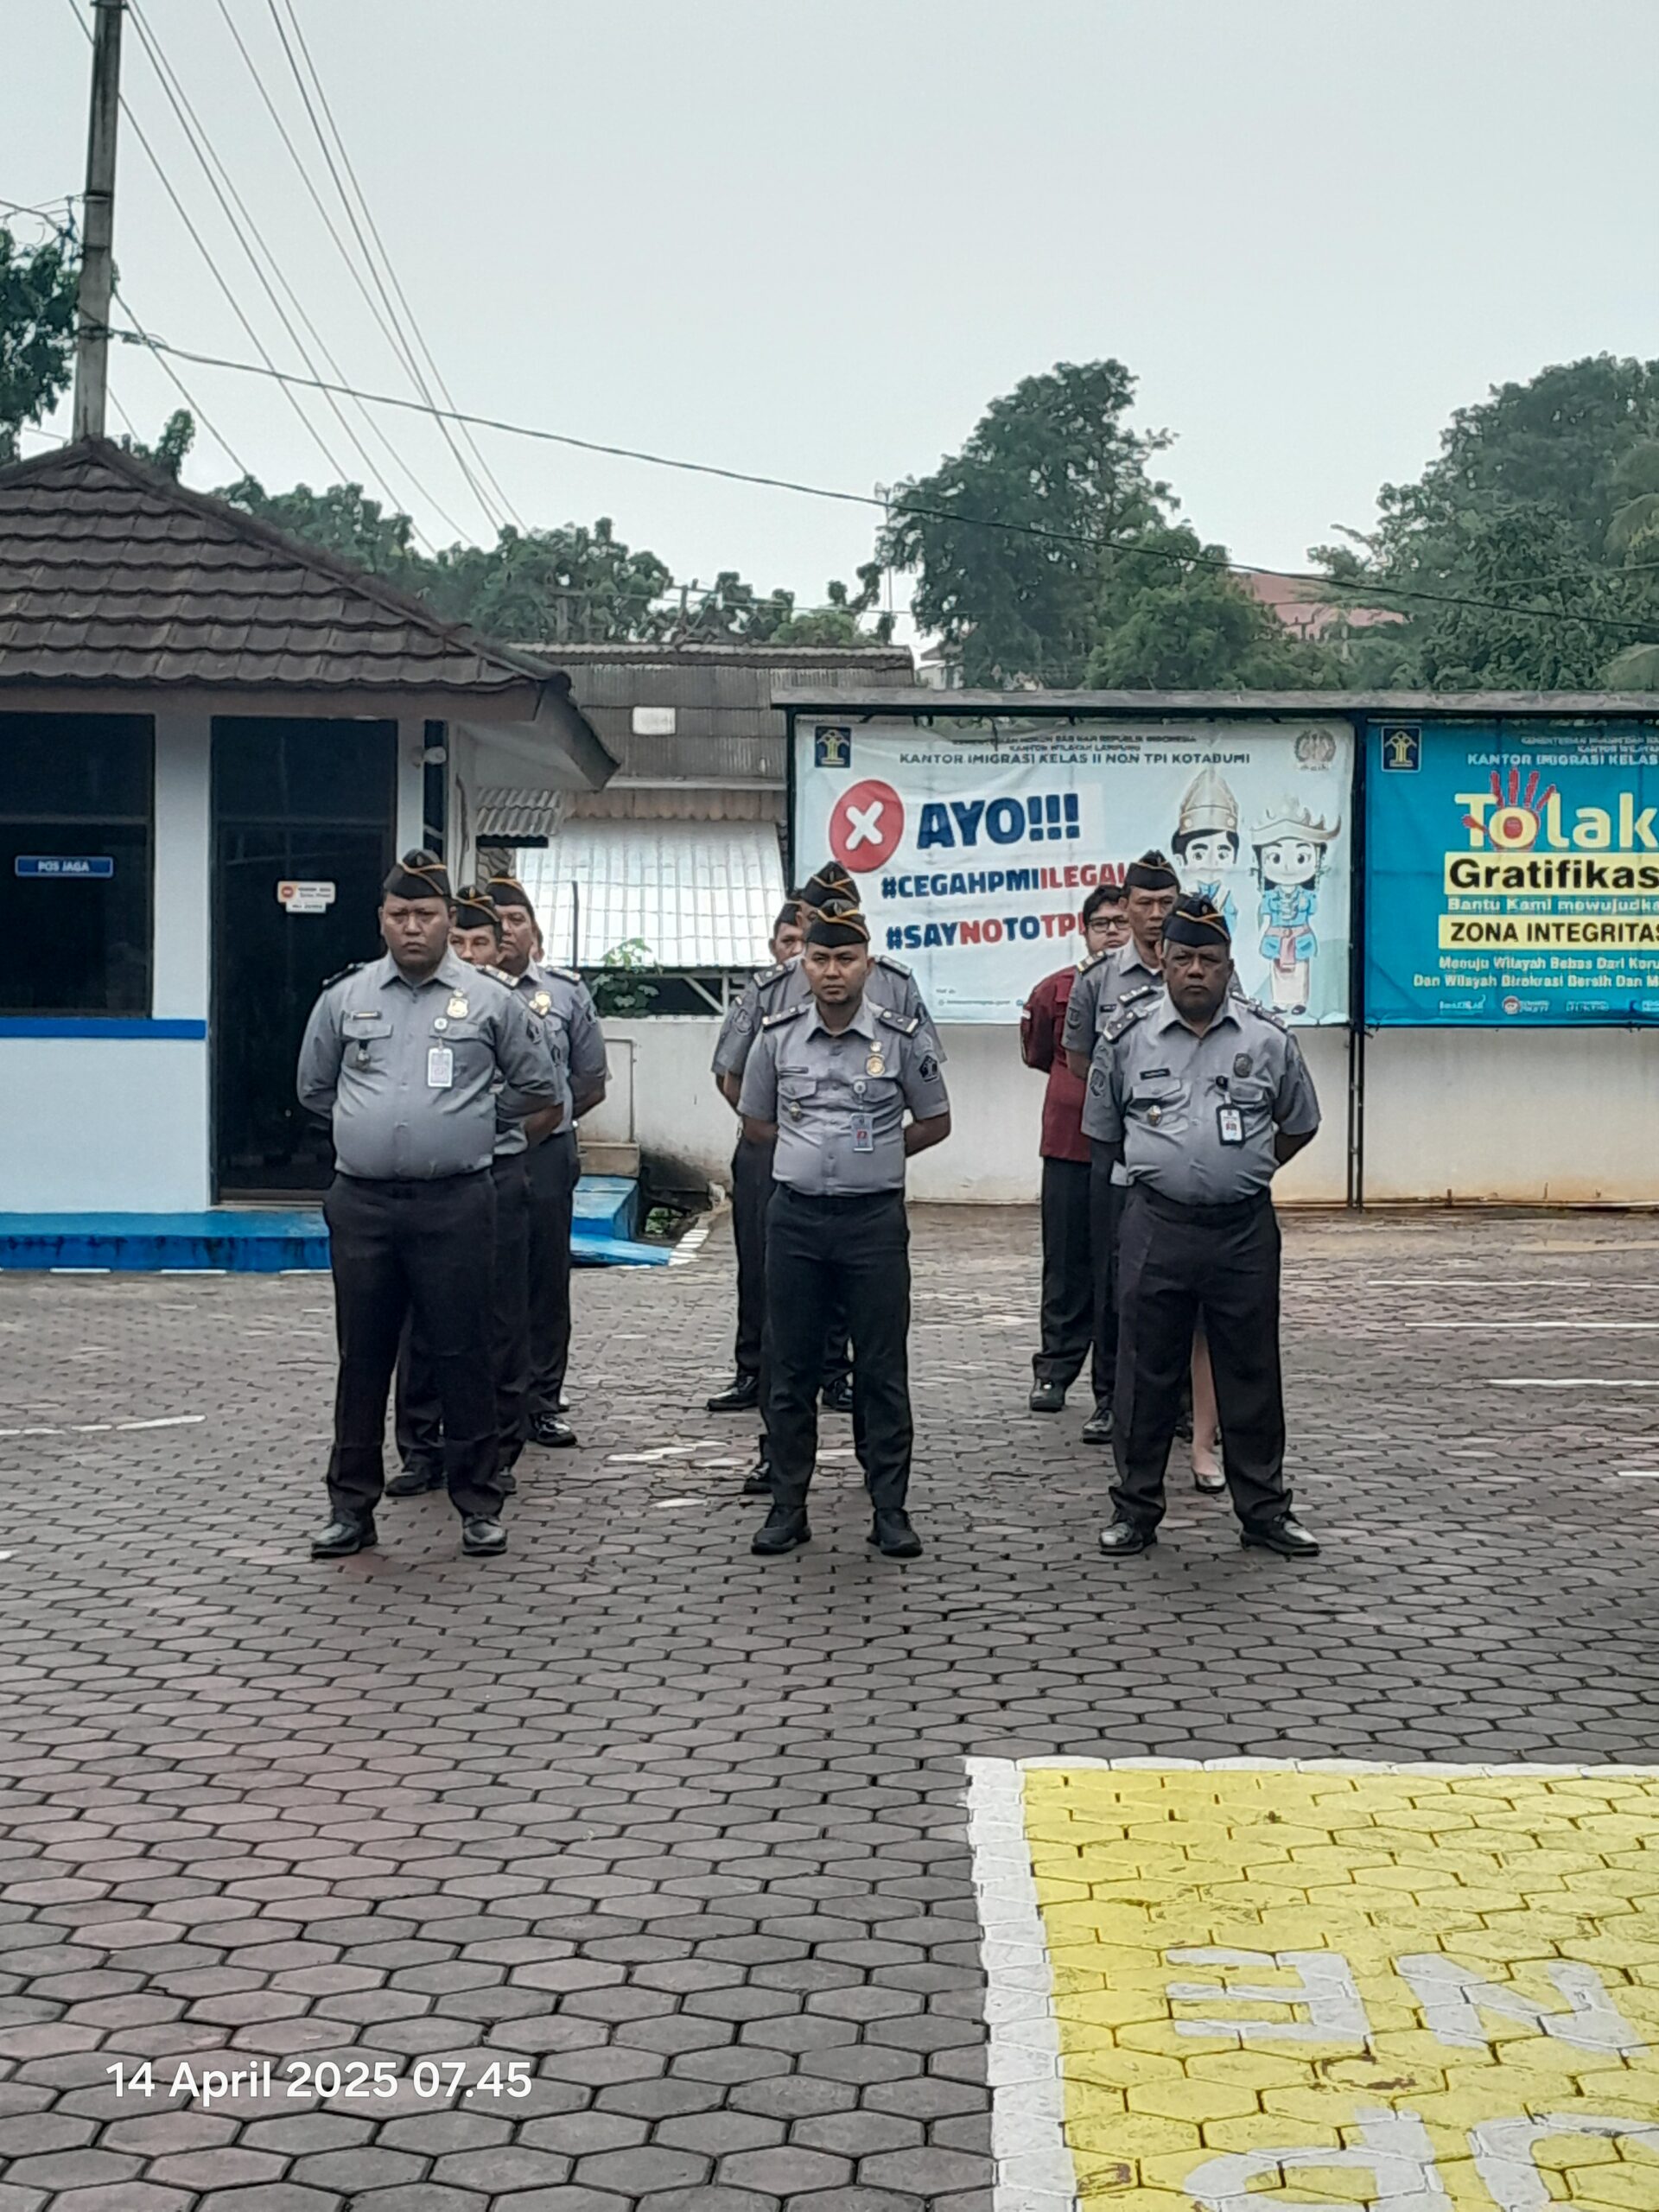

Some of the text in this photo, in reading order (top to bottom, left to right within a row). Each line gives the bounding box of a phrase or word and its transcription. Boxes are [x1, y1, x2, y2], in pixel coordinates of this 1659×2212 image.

[899, 753, 963, 764] KANTOR
[968, 753, 1035, 764] IMIGRASI
[1039, 753, 1088, 764] KELAS
[1092, 753, 1102, 764] II
[1105, 753, 1140, 764] NON
[1144, 753, 1167, 764] TPI
[1467, 753, 1659, 766] KANTOR IMIGRASI KELAS
[917, 793, 1082, 850] AYO!!!
[1454, 792, 1659, 849] Tolak
[1449, 858, 1659, 889] Gratifikas
[1448, 898, 1501, 912] Bantu
[1506, 898, 1553, 912] Kami
[1450, 922, 1519, 943] ZONA
[1439, 956, 1490, 971] Menuju
[1493, 956, 1547, 971] Wilayah
[1550, 957, 1592, 969] Bebas
[1596, 957, 1624, 969] Dari
[1414, 974, 1441, 987] Dan
[1445, 974, 1497, 990] Wilayah
[1501, 973, 1564, 988] Birokrasi
[1567, 974, 1612, 988] Bersih
[1616, 974, 1643, 988] Dan
